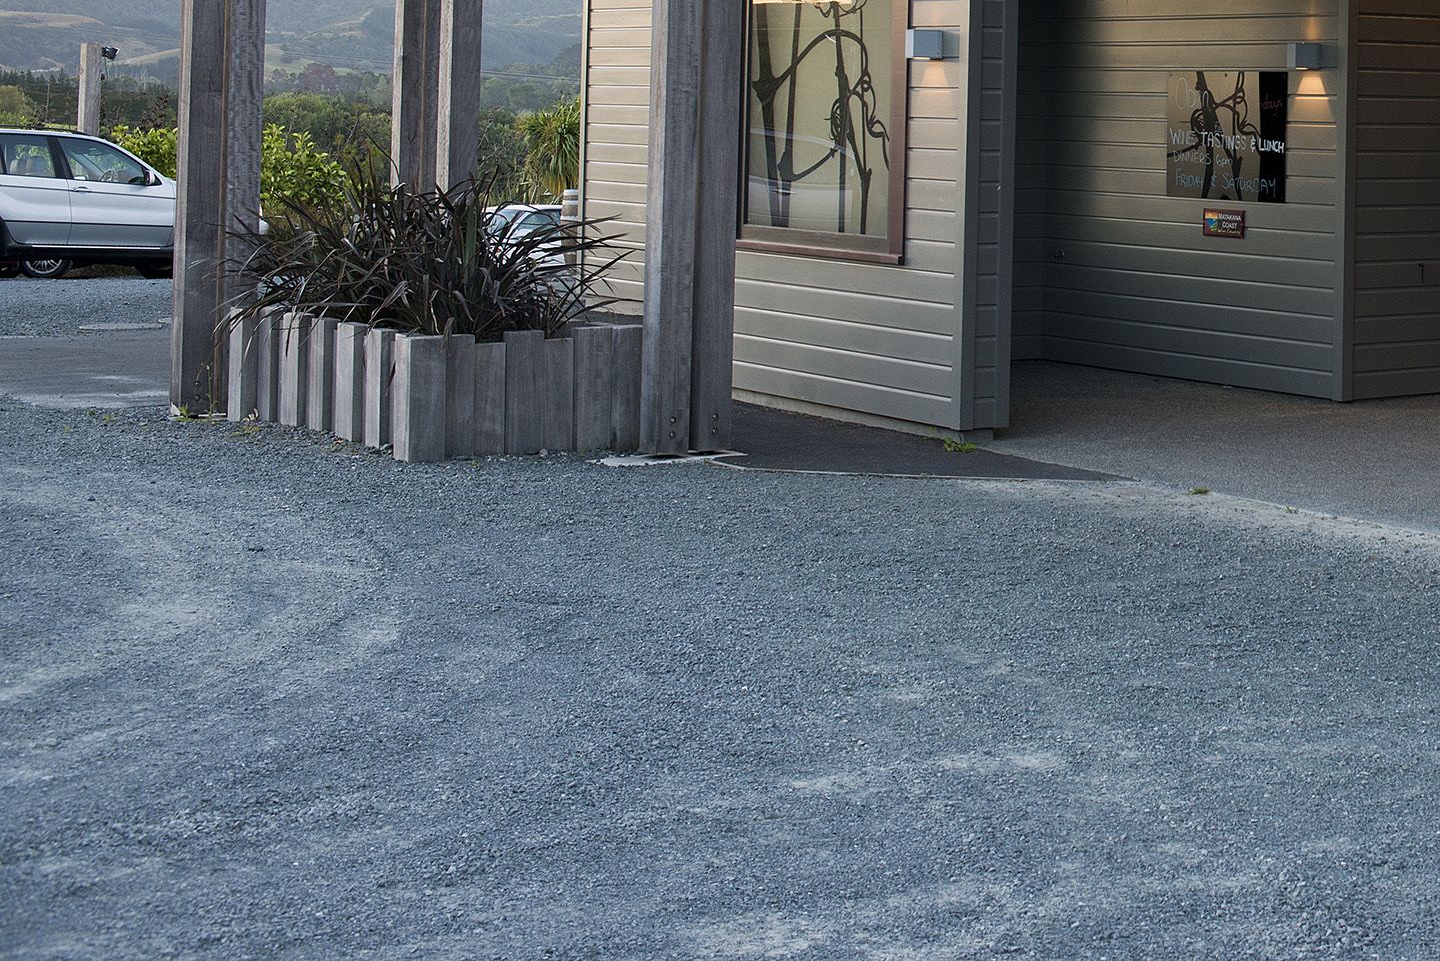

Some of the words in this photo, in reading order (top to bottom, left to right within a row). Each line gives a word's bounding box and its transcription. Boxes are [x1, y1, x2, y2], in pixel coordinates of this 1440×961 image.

[1175, 77, 1209, 112] Opn
[1201, 131, 1246, 150] TASTINGS
[1250, 137, 1257, 153] &
[1259, 138, 1285, 154] LUNCH
[1222, 172, 1276, 198] SATURDAY
[1218, 213, 1242, 222] MATAKANA
[1222, 221, 1237, 230] COAST
